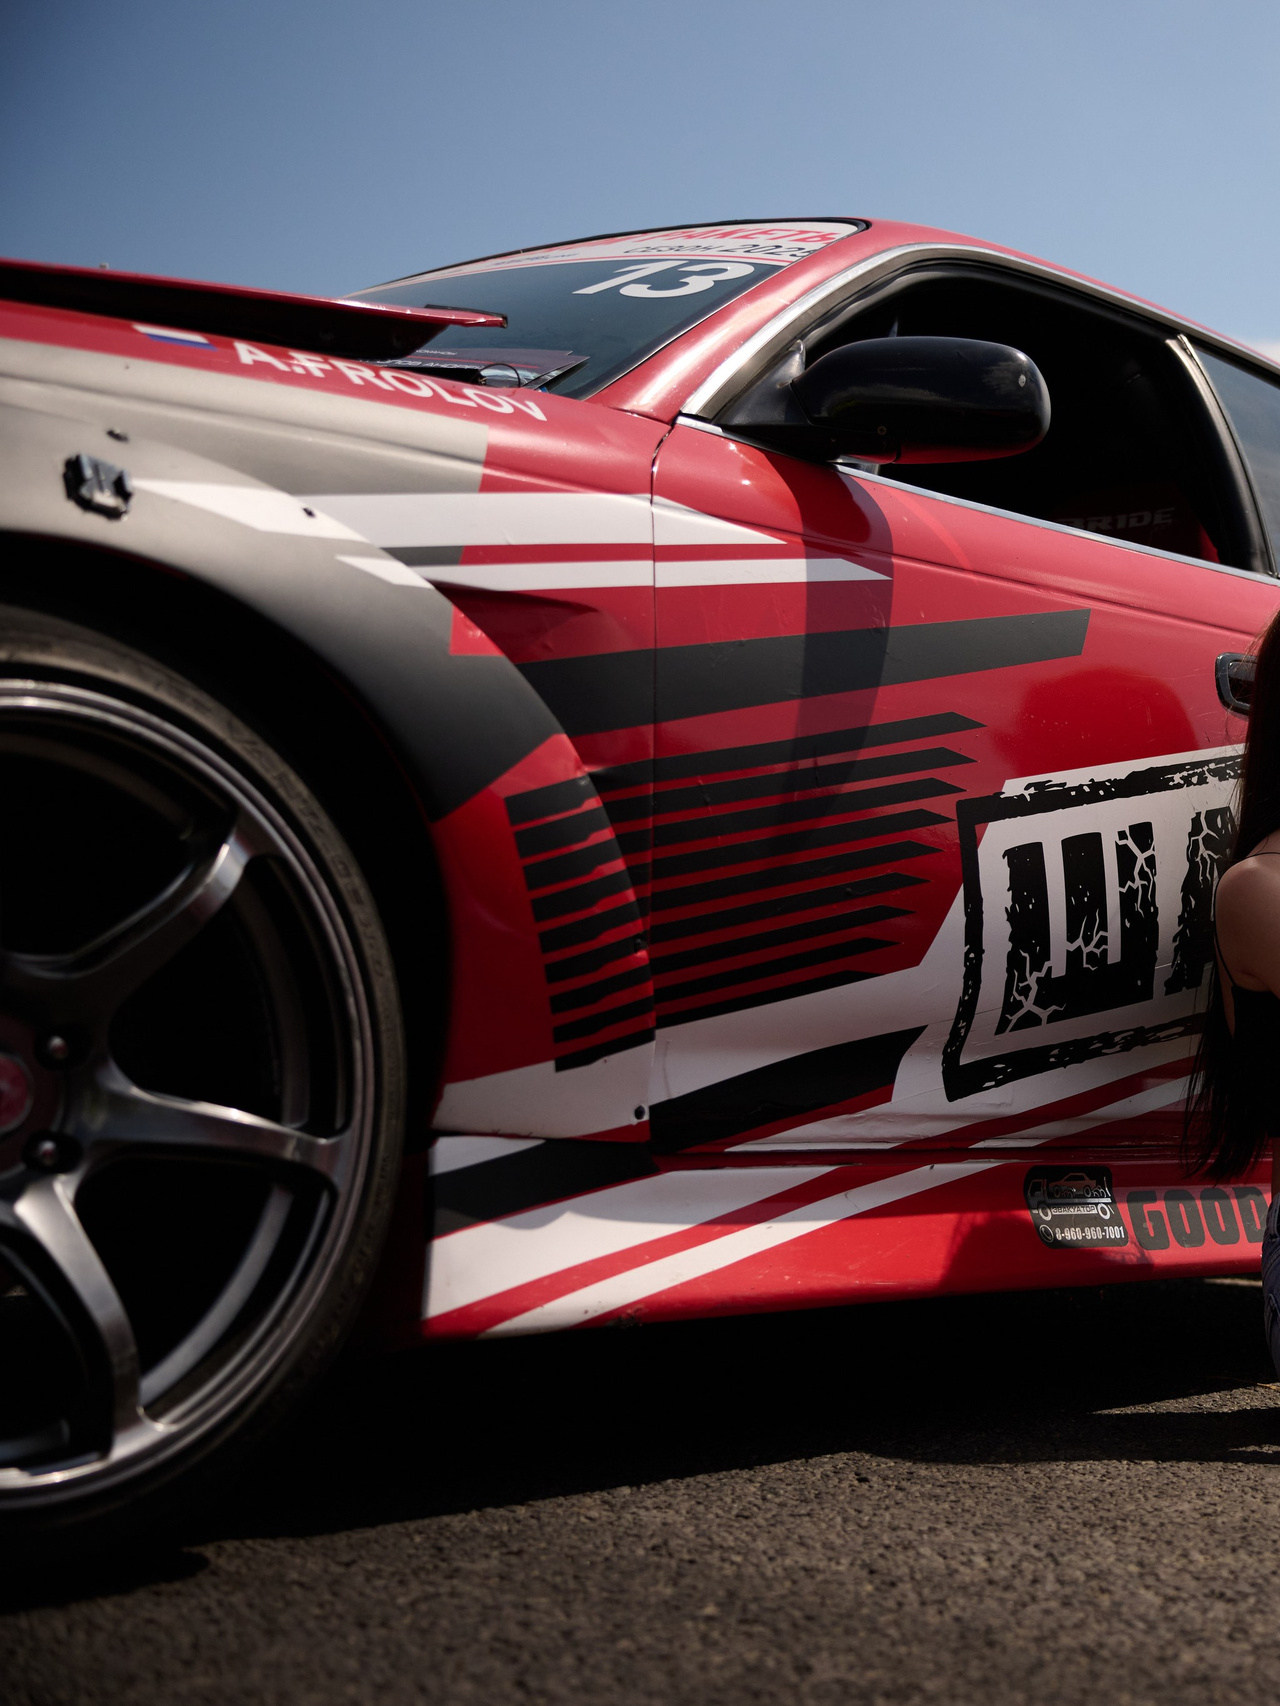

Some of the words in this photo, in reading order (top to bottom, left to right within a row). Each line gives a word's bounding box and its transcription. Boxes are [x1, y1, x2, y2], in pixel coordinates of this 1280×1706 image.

[571, 260, 755, 299] 13
[233, 340, 548, 422] A.FROLOV
[1052, 1205, 1097, 1214] ЭВАКУАТОР
[1055, 1226, 1125, 1241] 8-960-960-7001
